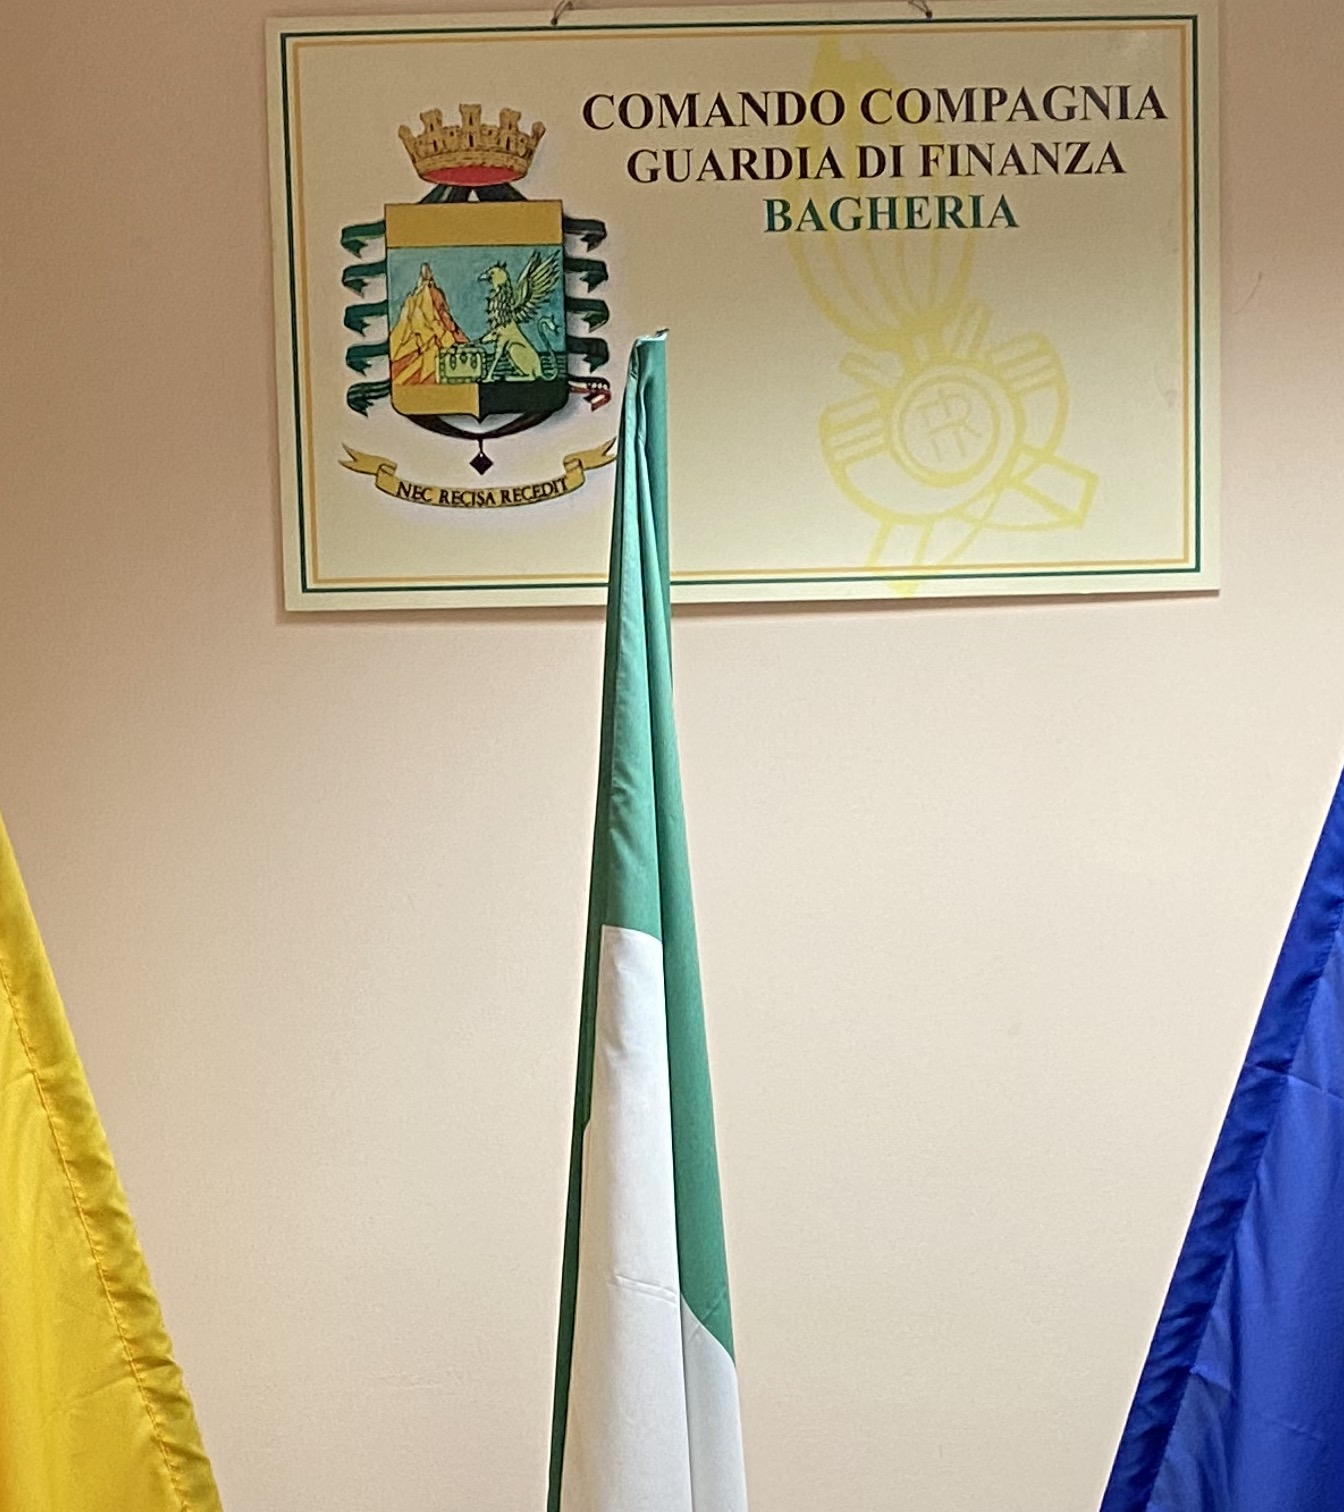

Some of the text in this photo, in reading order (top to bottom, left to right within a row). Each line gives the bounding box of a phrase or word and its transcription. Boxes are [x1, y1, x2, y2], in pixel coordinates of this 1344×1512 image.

[582, 84, 1169, 131] COMANDO COMPAGNIA
[626, 140, 1127, 184] GUARDIA DI FINANZA
[763, 193, 1020, 234] BAGHERIA
[395, 477, 569, 508] NEC RECISA RECEDIT
